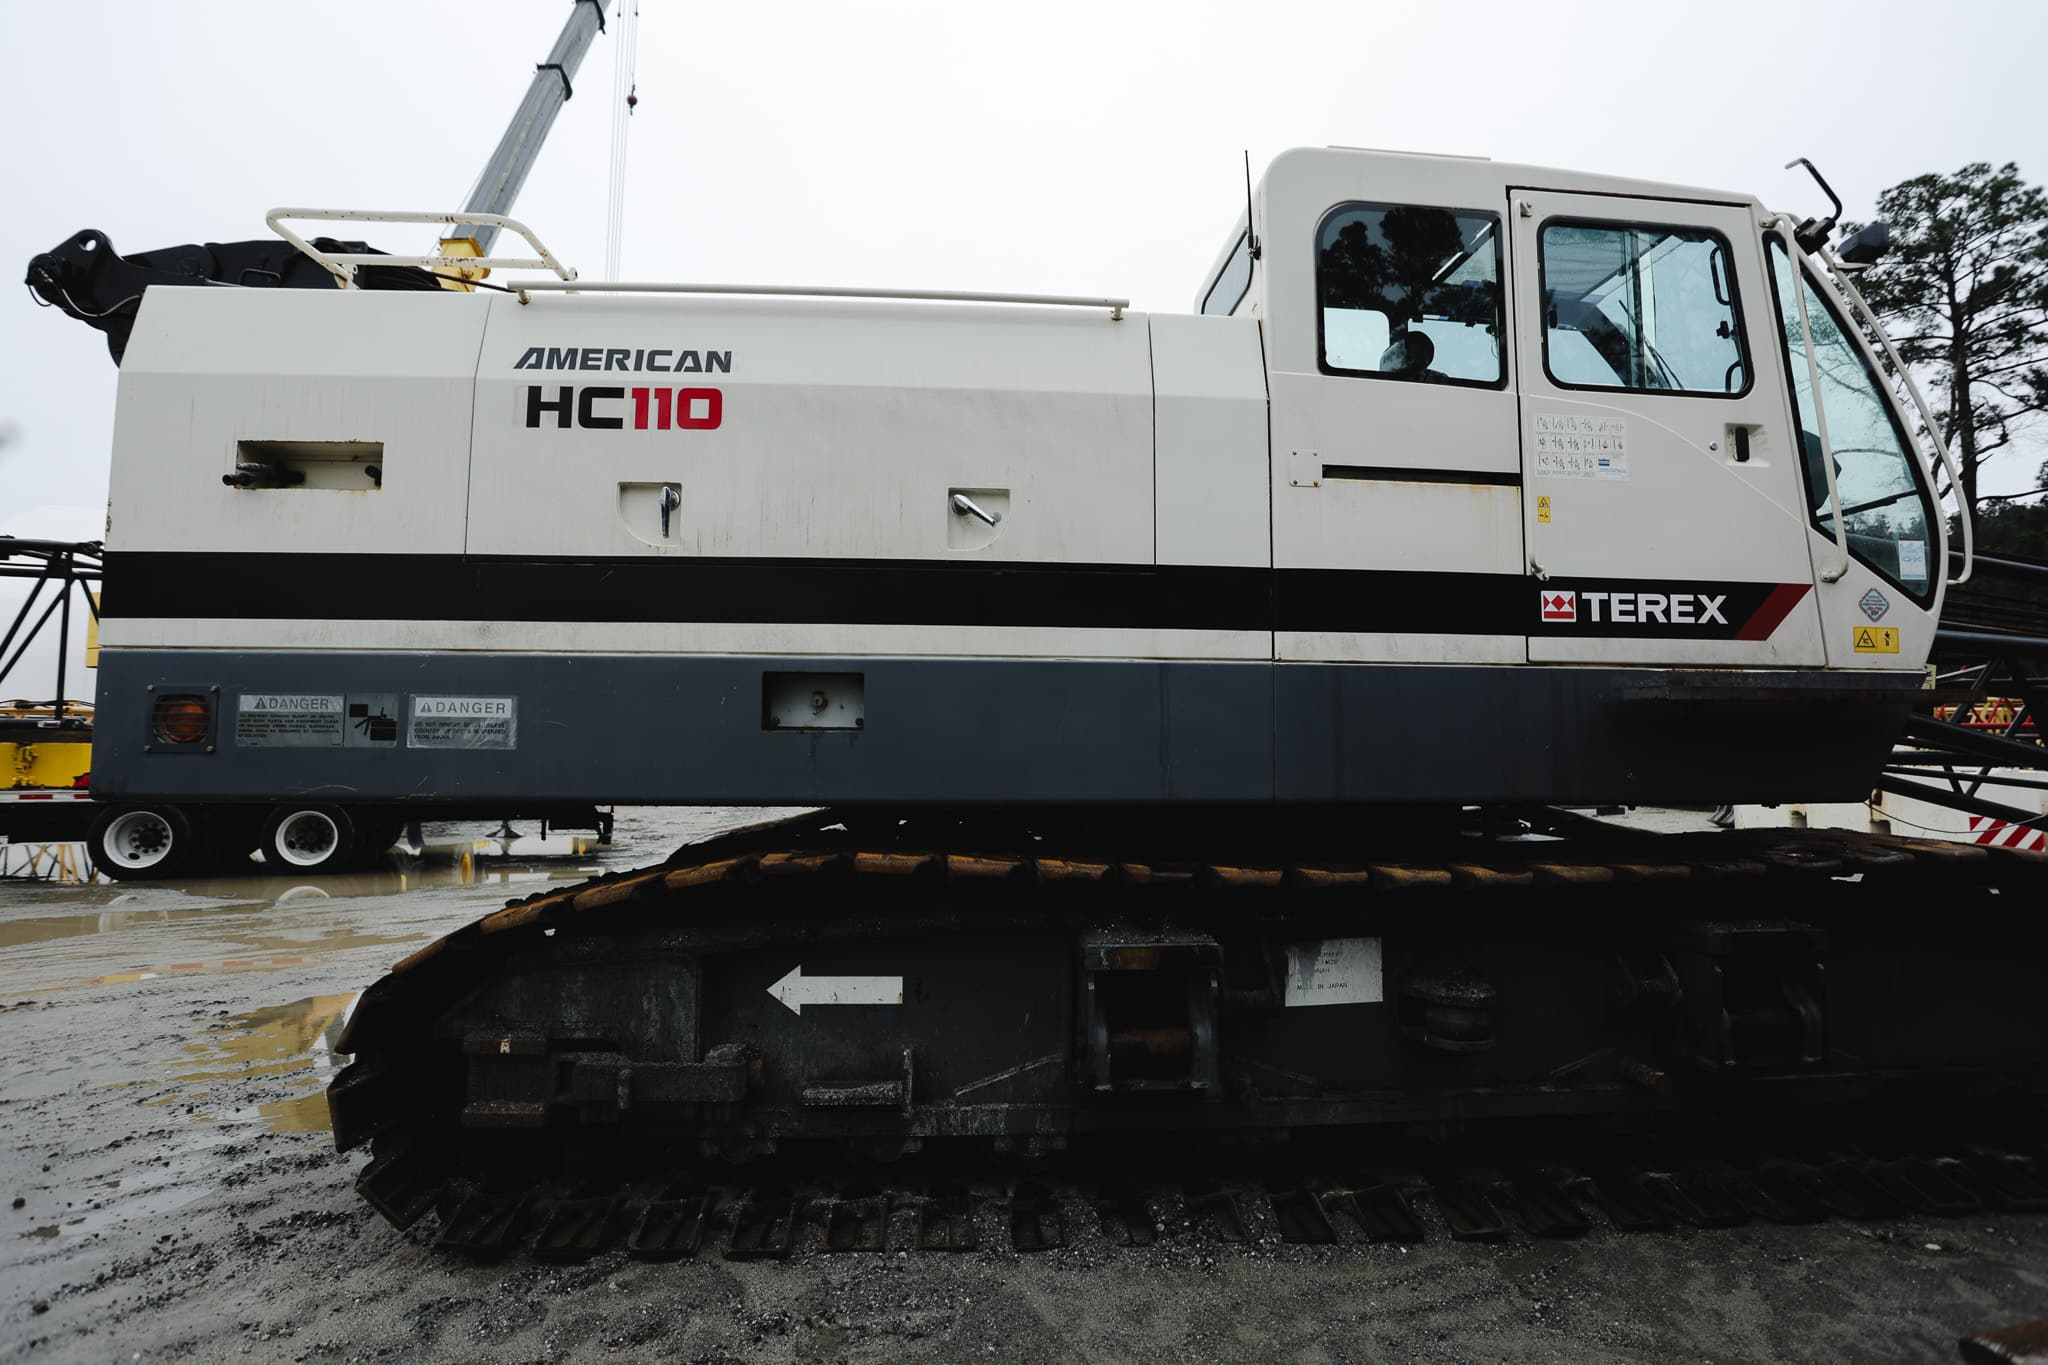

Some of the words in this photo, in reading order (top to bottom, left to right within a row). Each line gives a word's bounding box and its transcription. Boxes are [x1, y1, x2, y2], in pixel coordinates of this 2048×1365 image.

[512, 347, 732, 373] AMERICAN
[525, 386, 723, 430] HC110
[1581, 592, 1729, 625] TEREX
[269, 697, 329, 710] DANGER
[435, 701, 506, 715] DANGER
